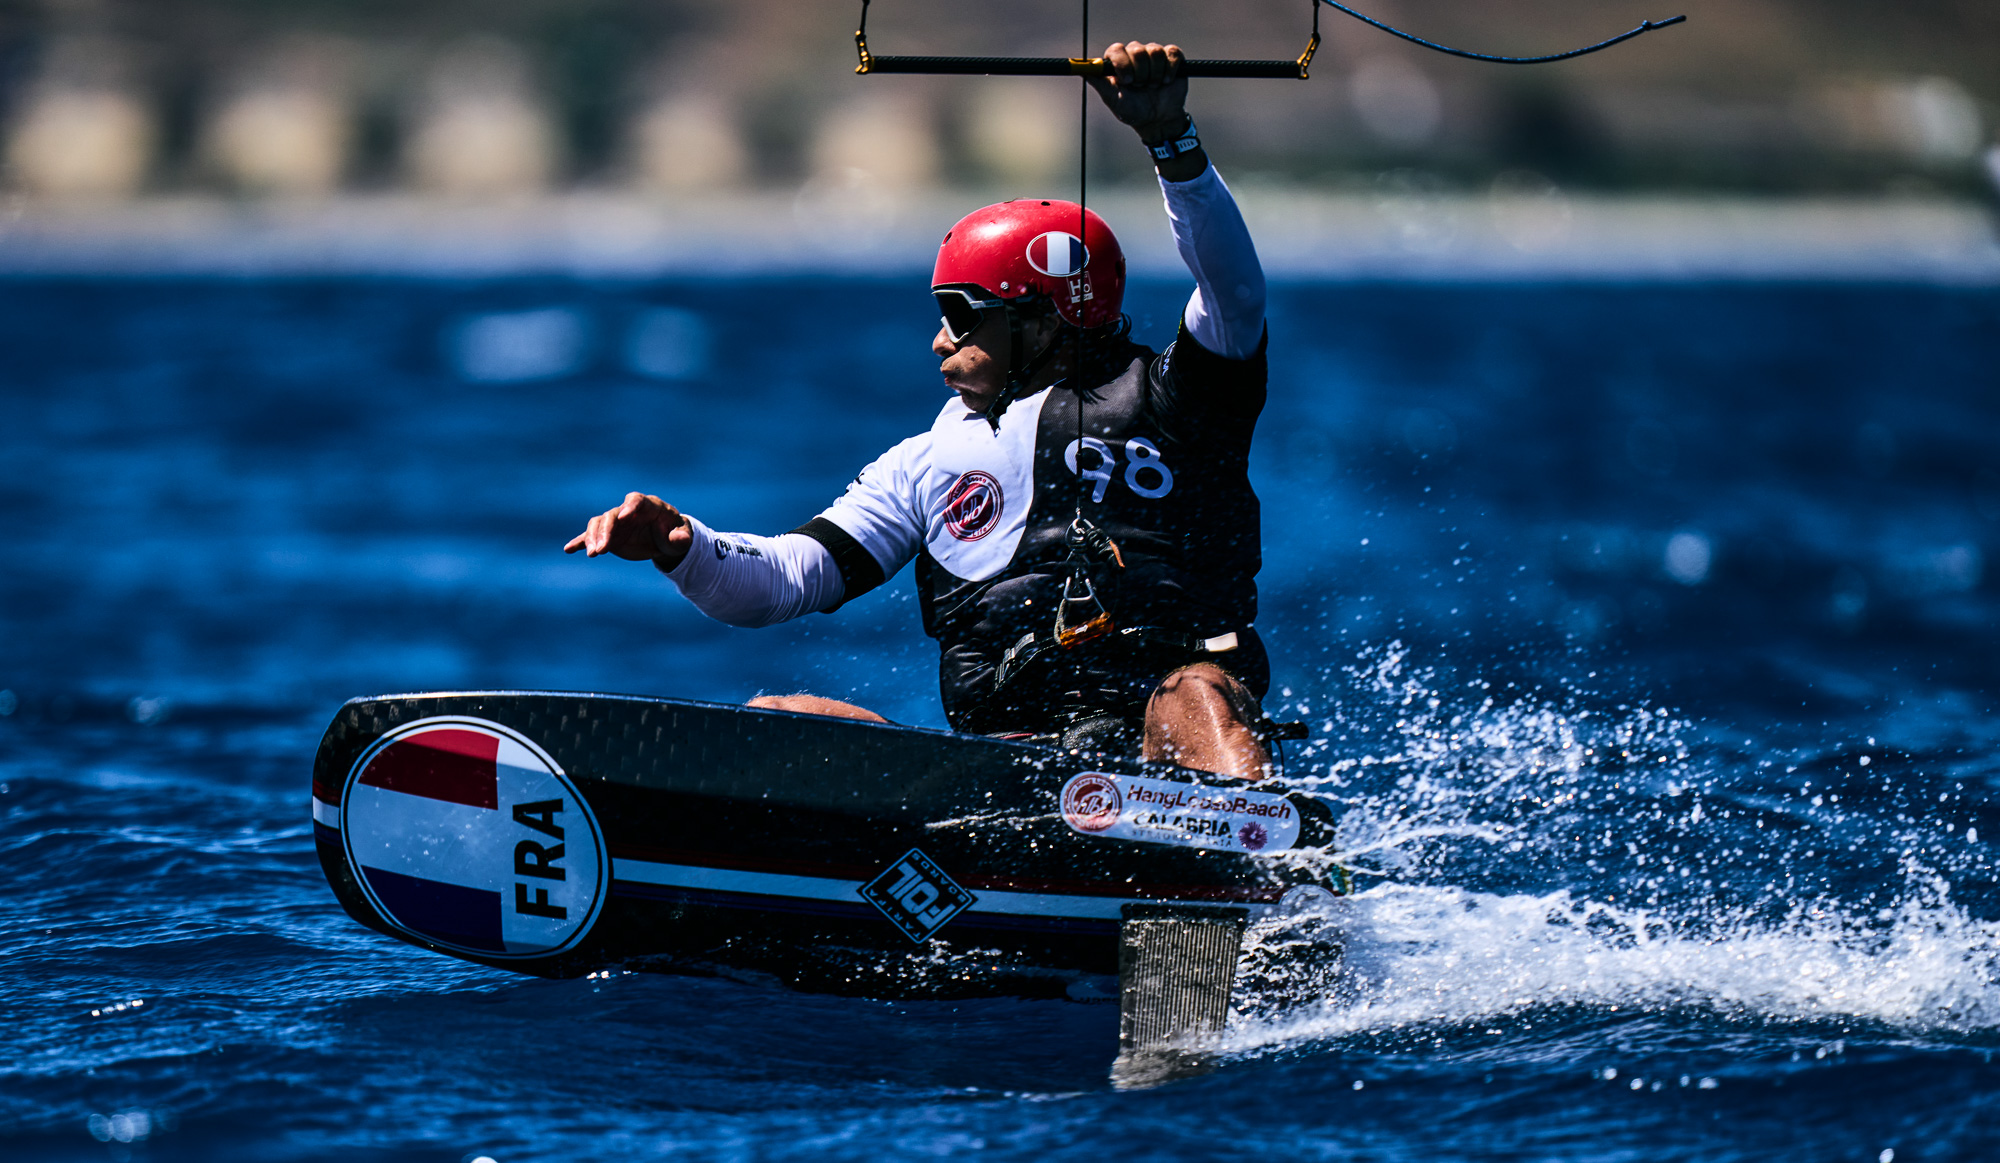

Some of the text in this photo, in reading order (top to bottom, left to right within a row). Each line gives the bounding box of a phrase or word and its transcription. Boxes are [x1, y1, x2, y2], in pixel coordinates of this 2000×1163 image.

[1064, 437, 1174, 503] 98
[1133, 812, 1233, 838] CALABRIA
[512, 798, 567, 920] FRA
[911, 852, 967, 903] BOARDS
[868, 888, 922, 940] TARIFA
[886, 861, 956, 930] FOIL
